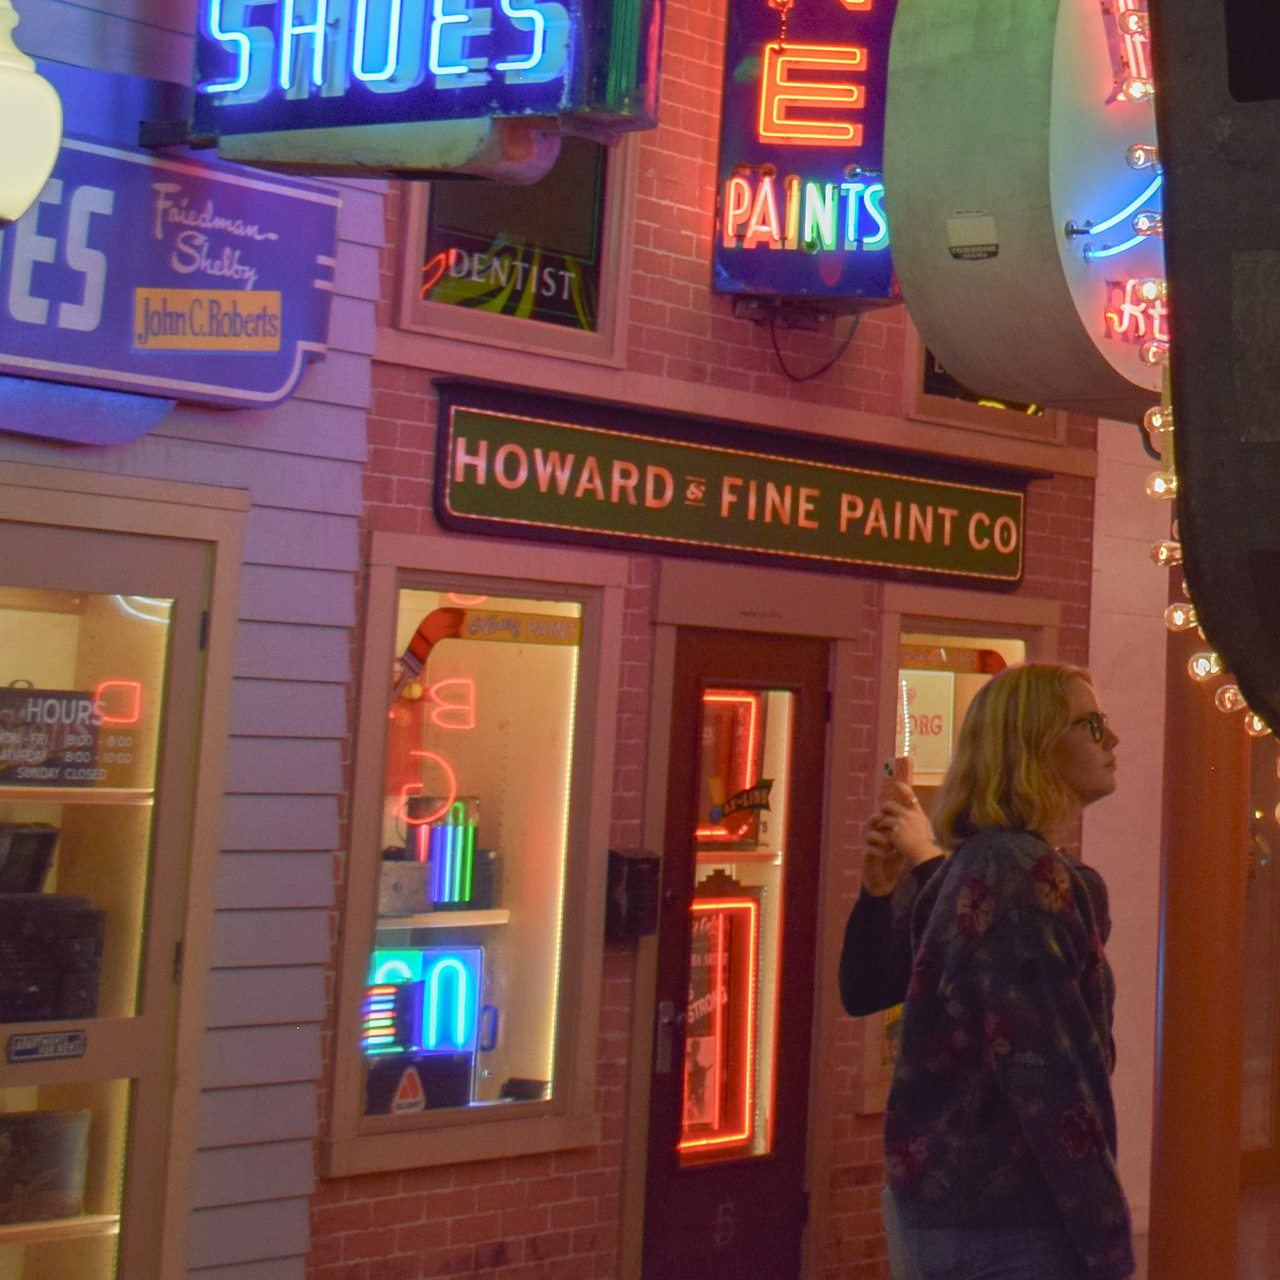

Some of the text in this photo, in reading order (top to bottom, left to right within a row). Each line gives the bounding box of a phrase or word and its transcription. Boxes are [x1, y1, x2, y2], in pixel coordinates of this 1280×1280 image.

[724, 176, 889, 252] PAINTS
[171, 229, 259, 292] Shelby
[444, 246, 578, 303] DENTIST
[137, 296, 185, 345] John
[206, 299, 279, 337] Roberts
[453, 436, 674, 510] HOWARD
[720, 476, 820, 530] FINE
[840, 493, 958, 548] PAINT
[967, 512, 1018, 556] CO
[26, 697, 107, 726] HOURS
[0, 749, 48, 762] ATURDAY
[65, 751, 91, 763] 8:00
[17, 767, 108, 781] SUNDAY CLOSED
